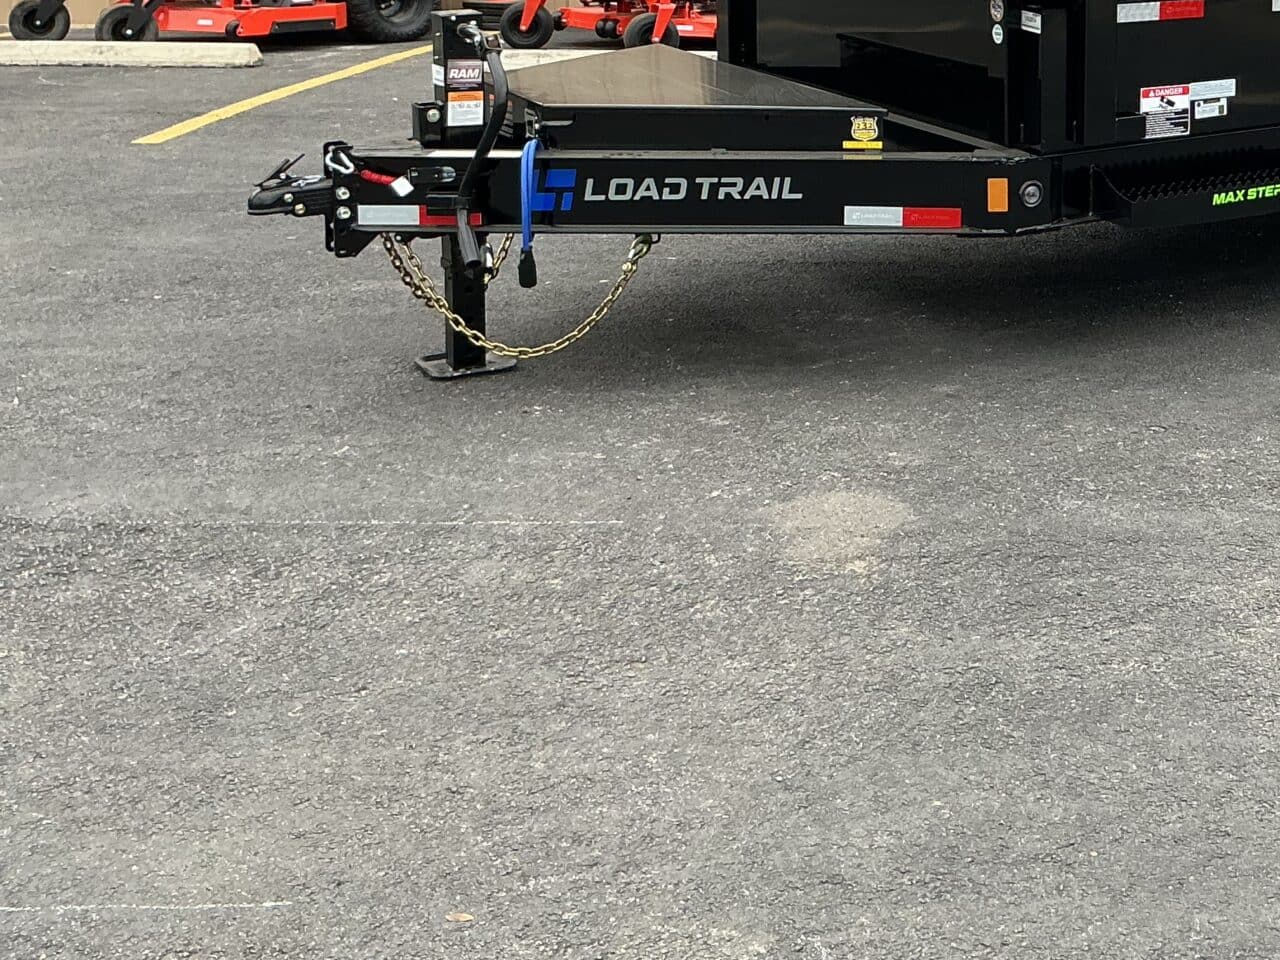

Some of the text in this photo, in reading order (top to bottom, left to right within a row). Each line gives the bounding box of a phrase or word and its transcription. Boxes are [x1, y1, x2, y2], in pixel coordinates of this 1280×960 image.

[449, 68, 480, 79] RAM
[1155, 87, 1184, 97] DANGER
[584, 176, 804, 201] LOAD TRAIL
[1212, 189, 1246, 206] MAX
